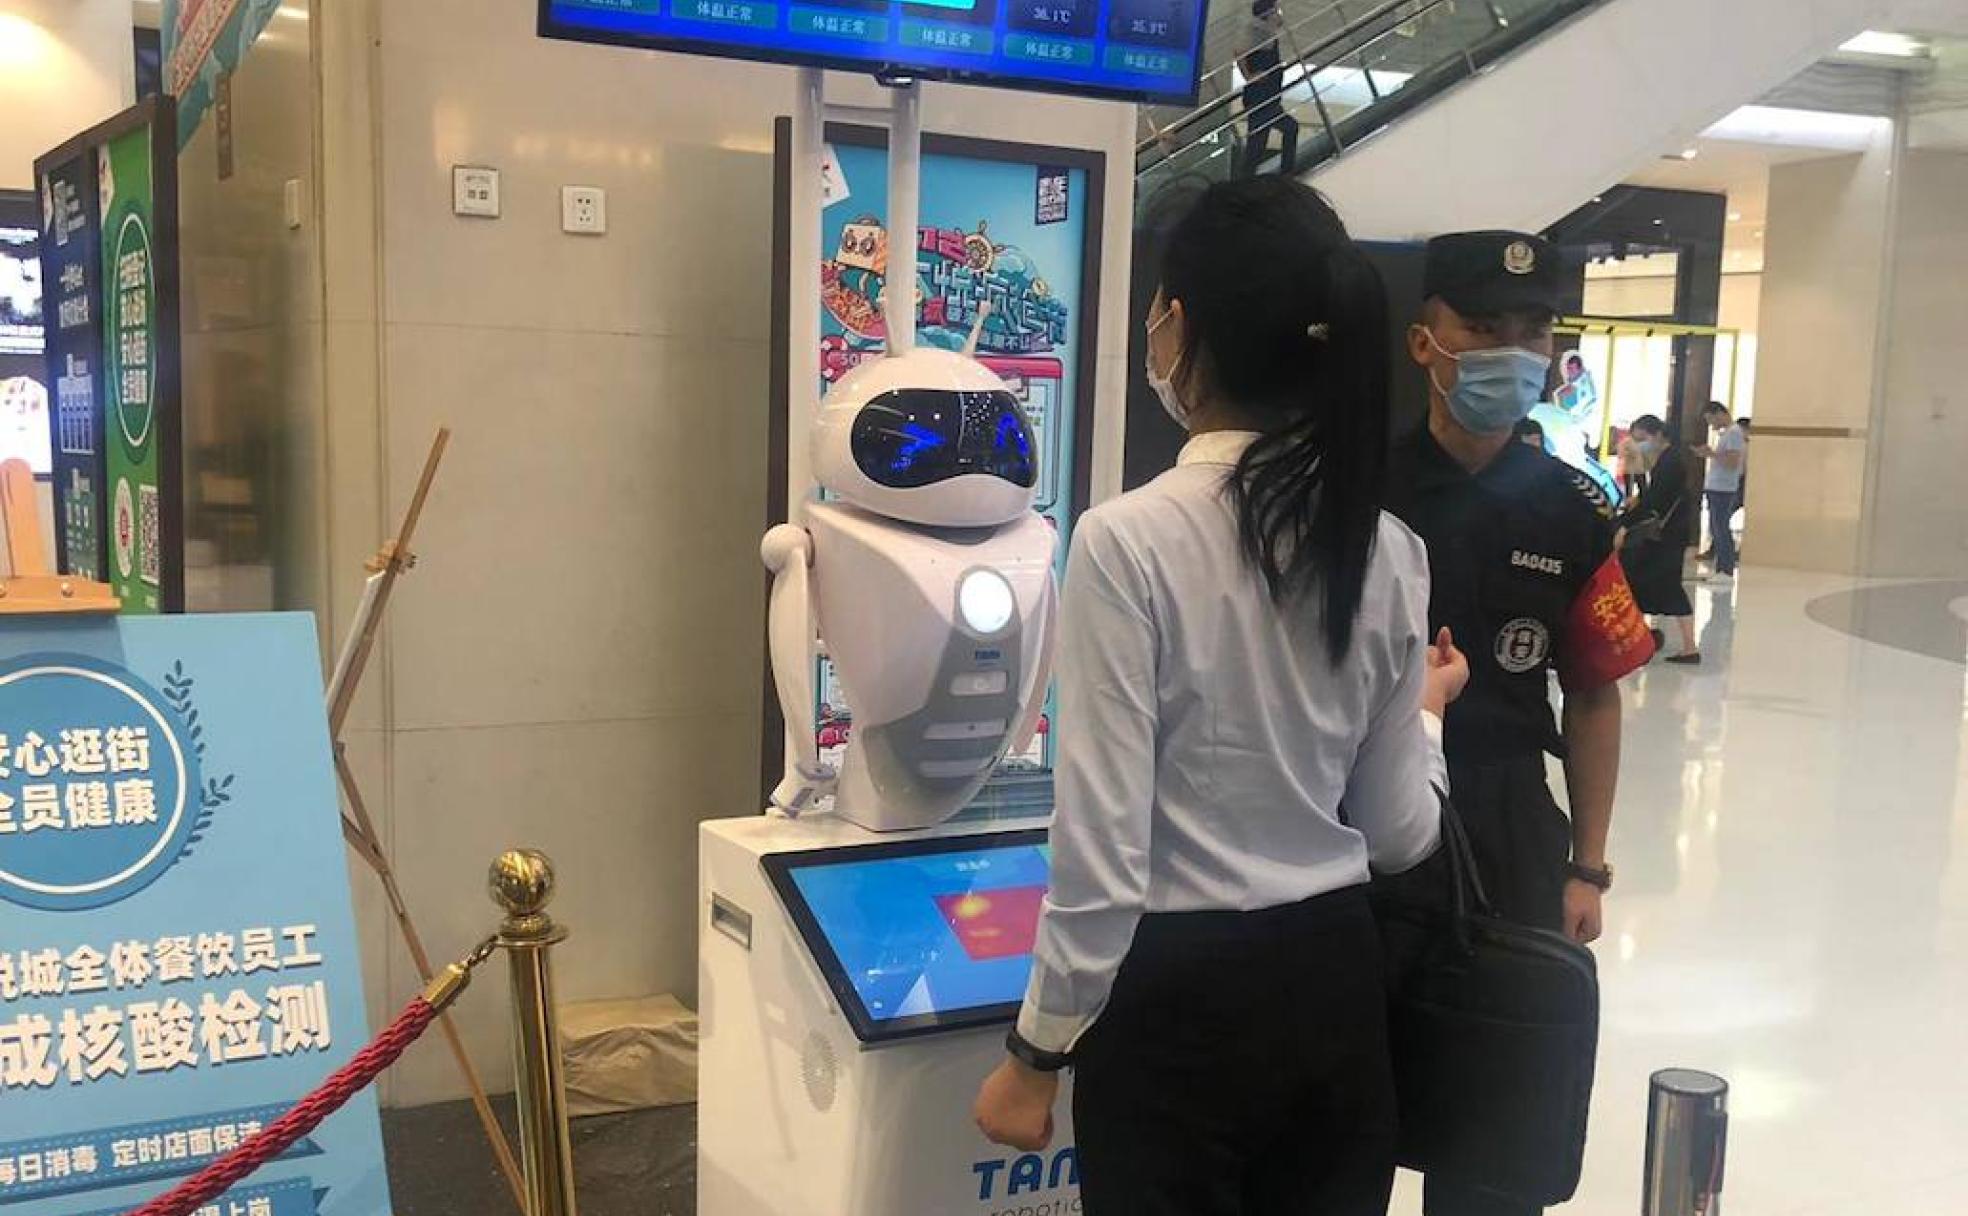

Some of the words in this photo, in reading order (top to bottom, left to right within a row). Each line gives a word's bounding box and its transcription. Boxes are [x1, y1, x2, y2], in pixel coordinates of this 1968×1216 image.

[0, 726, 150, 778] 心逛街
[0, 981, 331, 1089] 成核酸检测
